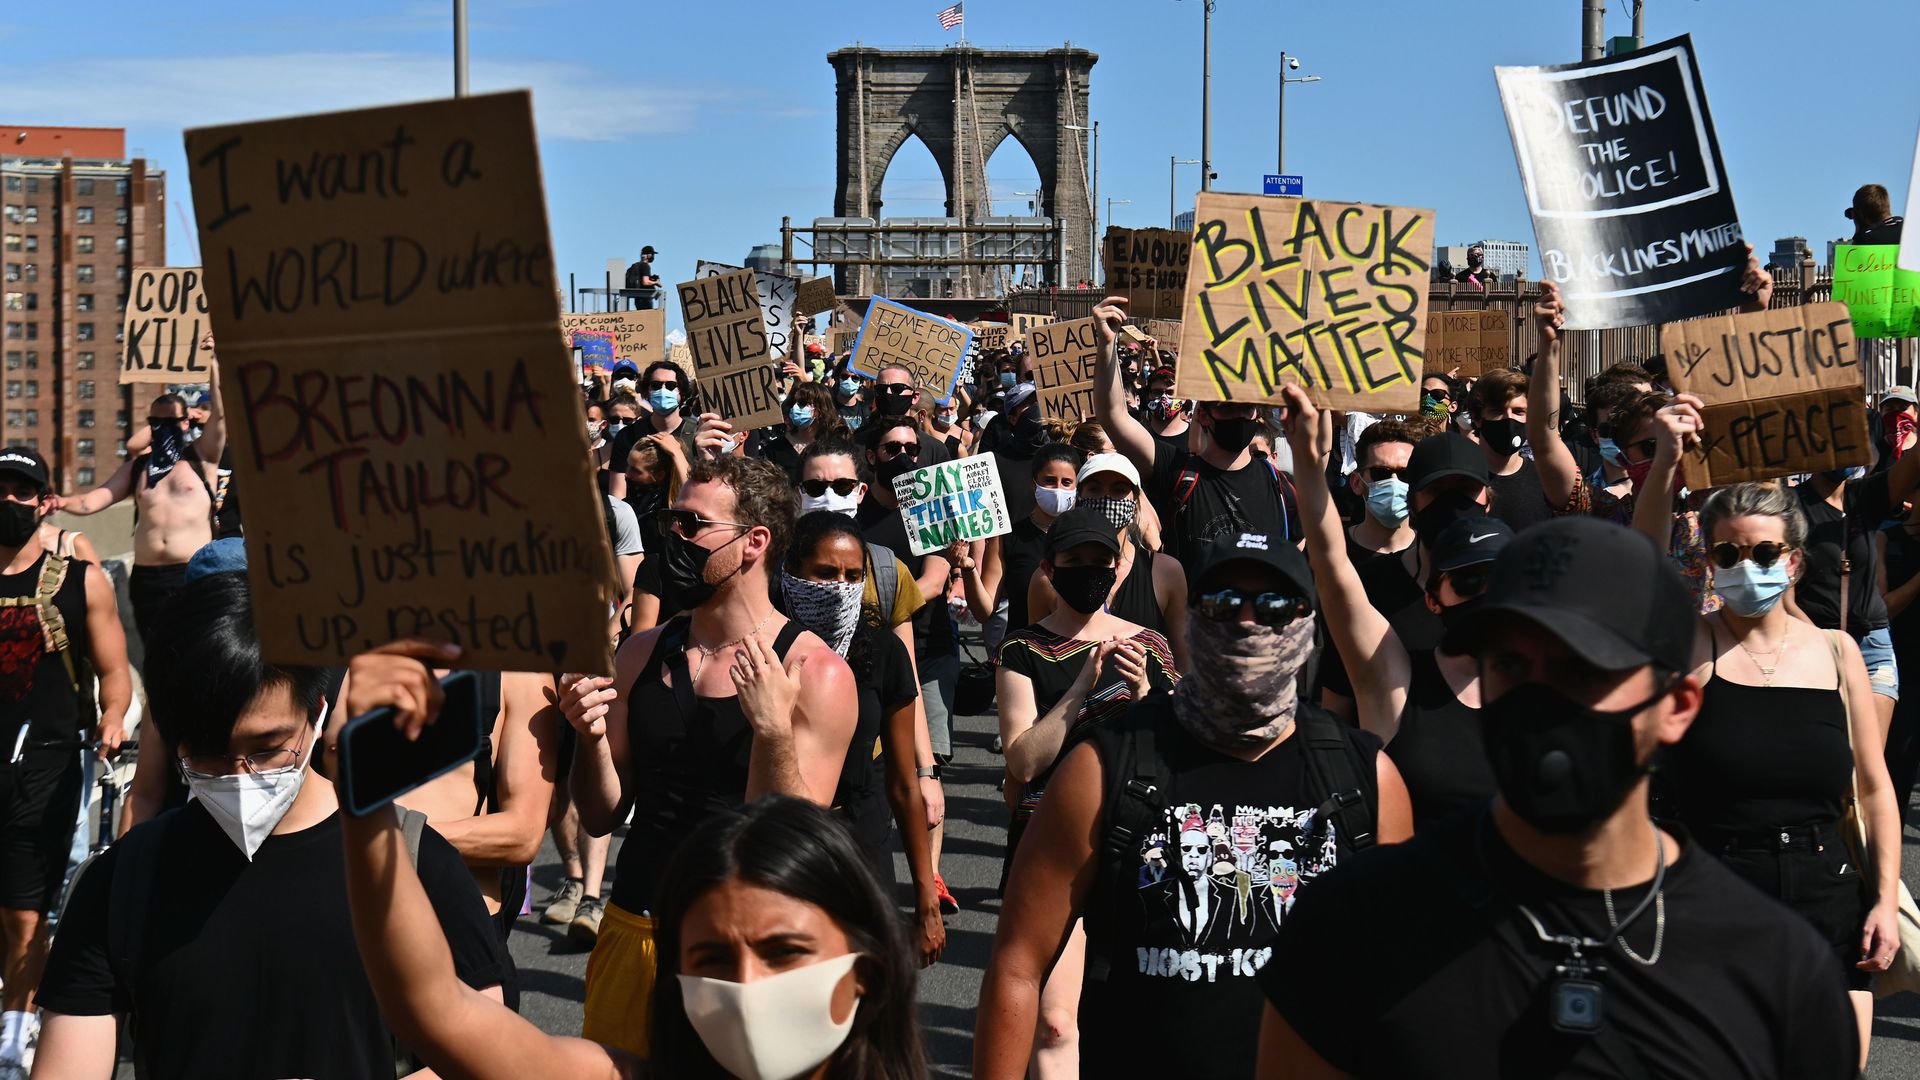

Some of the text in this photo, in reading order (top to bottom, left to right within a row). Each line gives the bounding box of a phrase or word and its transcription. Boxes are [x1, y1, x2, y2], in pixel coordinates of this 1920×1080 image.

[1579, 137, 1631, 165] THE
[200, 124, 483, 231] I want a
[1266, 177, 1301, 185] ATTENTION
[1578, 151, 1680, 200] OLICE!
[1112, 235, 1189, 268] ENOUG
[1194, 201, 1429, 290] BLACK
[1621, 240, 1682, 276] LIVES
[1680, 222, 1744, 263] MATTER
[227, 229, 550, 321] WORLD where
[1113, 267, 1187, 290] IS ENOU
[680, 273, 760, 323] BLACK
[1198, 262, 1422, 350] LIVES
[126, 318, 208, 372] KILL
[562, 317, 625, 328] UCK CUOMO
[690, 318, 767, 370] LIVES
[877, 307, 962, 352] TIME FOR
[987, 327, 1008, 336] LIVES
[1150, 320, 1180, 337] BLM
[1445, 316, 1476, 333] MORE
[1481, 314, 1505, 331] COPS
[620, 344, 648, 352] YORK
[874, 325, 955, 371] POLICE
[1199, 314, 1424, 402] MATTER
[1436, 347, 1462, 364] MORE
[1466, 346, 1505, 363] PRISONS
[1711, 319, 1857, 387] JUSTICE
[700, 365, 781, 421] MATTER
[1039, 353, 1097, 389] LIVE
[236, 358, 548, 473] BREONNA
[1045, 388, 1096, 419] MATT
[1730, 402, 1857, 470] PEACE
[912, 462, 964, 500] SAY
[963, 461, 989, 472] TAYLOR
[299, 446, 530, 551] TAYLOR
[909, 488, 986, 526] THEIR
[919, 509, 993, 549] NAMES
[262, 519, 600, 608] is just waking
